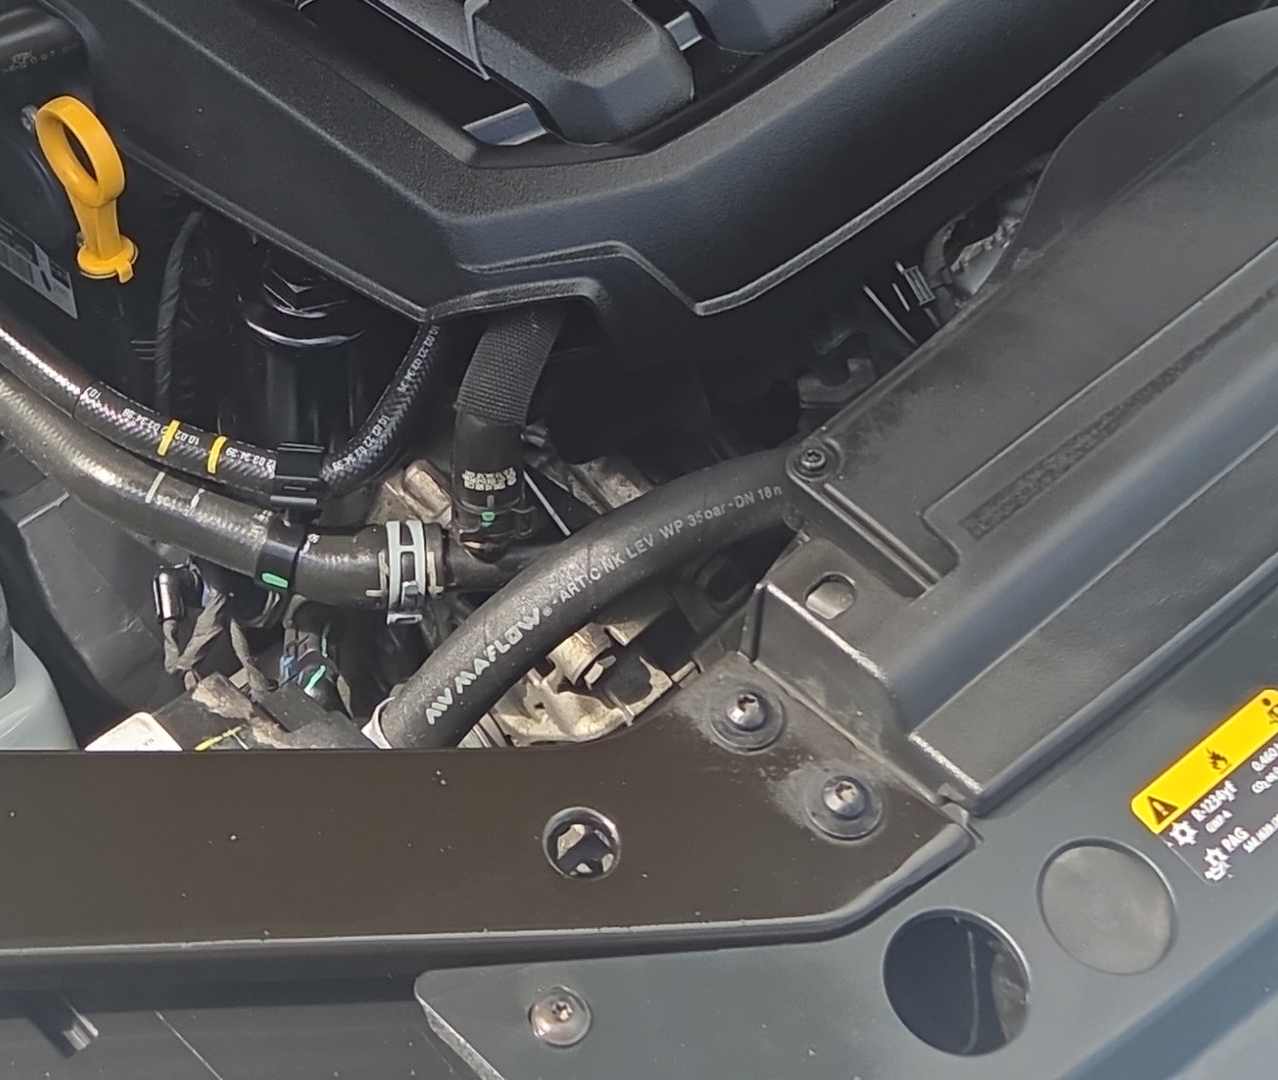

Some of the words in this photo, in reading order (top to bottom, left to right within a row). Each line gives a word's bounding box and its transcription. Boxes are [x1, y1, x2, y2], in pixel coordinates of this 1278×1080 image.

[626, 534, 655, 558] LEV
[659, 520, 684, 540] WP
[1190, 780, 1239, 823] R-1234yf
[1221, 825, 1248, 850] PAG
